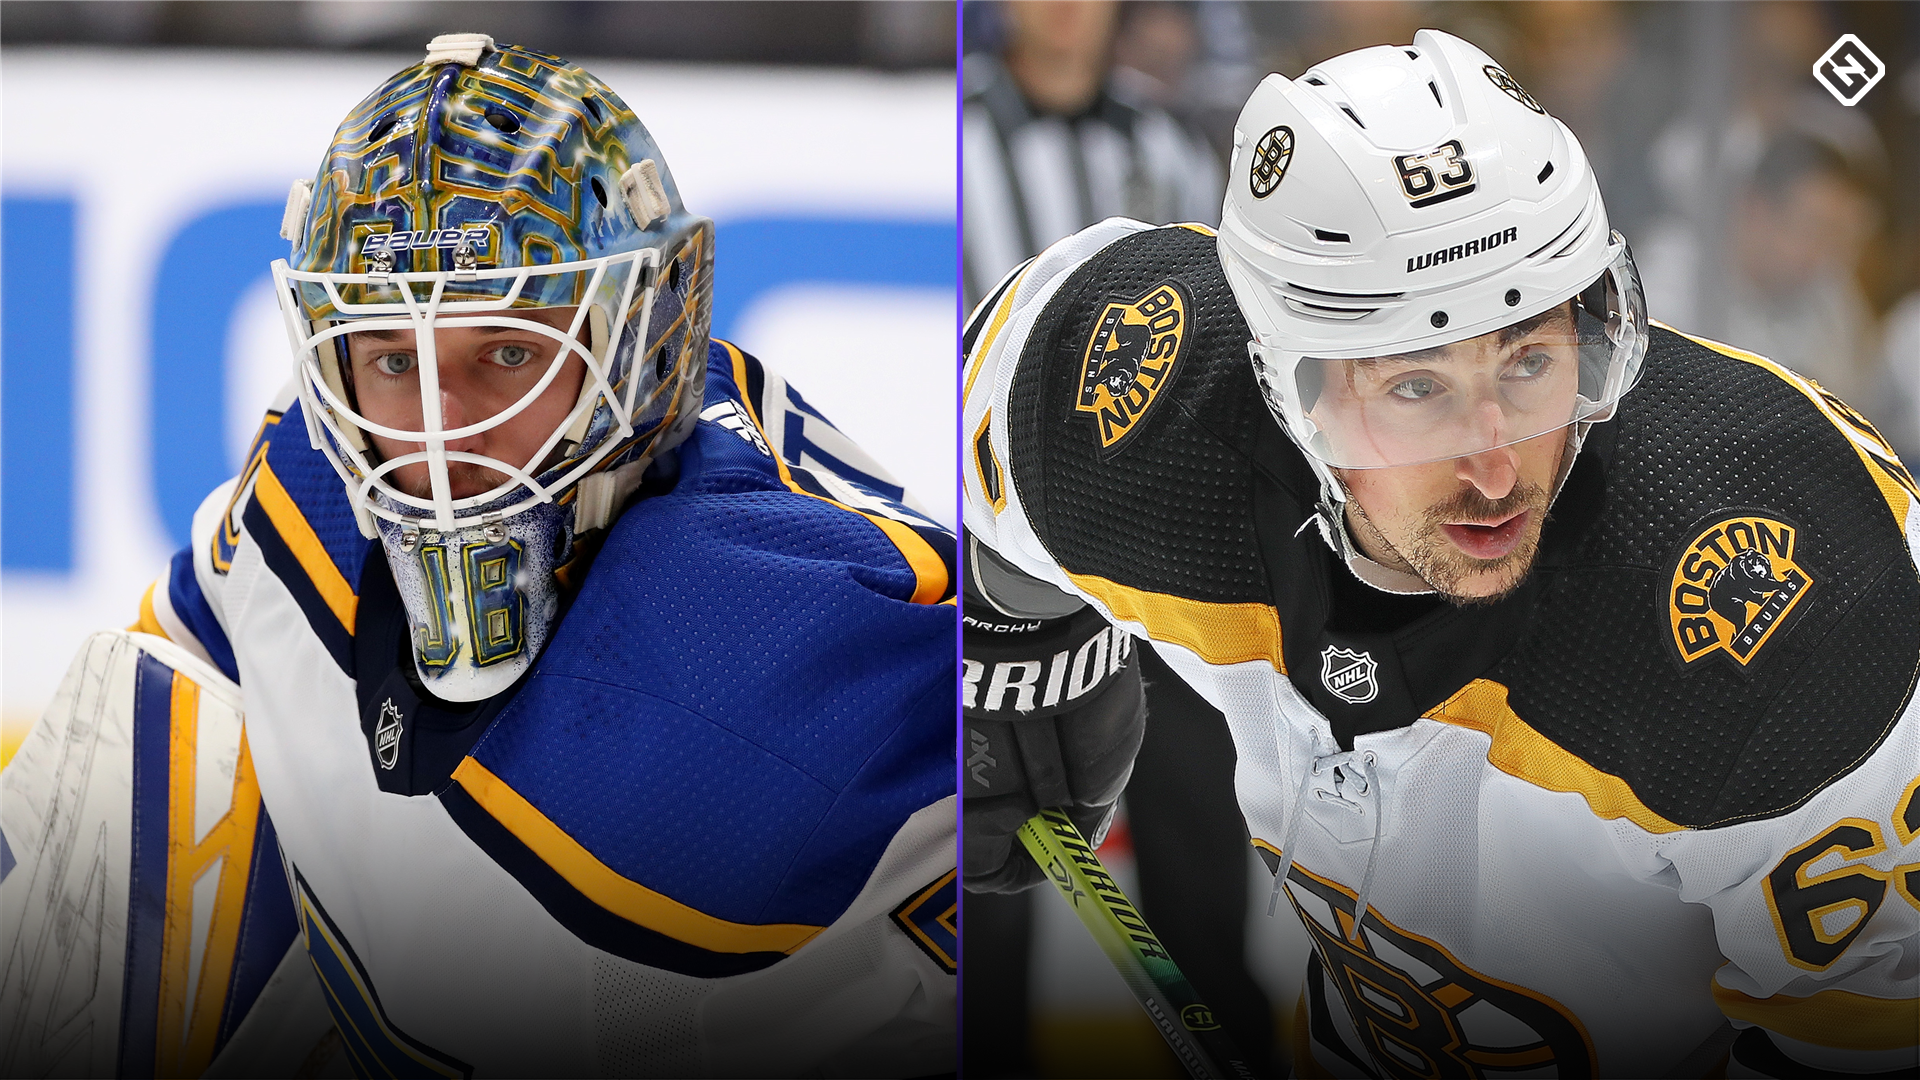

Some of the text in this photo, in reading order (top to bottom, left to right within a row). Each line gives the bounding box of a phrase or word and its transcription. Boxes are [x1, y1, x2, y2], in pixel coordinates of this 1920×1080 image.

[1392, 139, 1476, 201] 63
[1406, 226, 1519, 274] WARRIOR
[1084, 317, 1115, 394] BRUINS
[1100, 289, 1181, 442] BOSTON
[419, 537, 528, 669] JB
[1674, 521, 1790, 656] BOSTON
[1743, 581, 1798, 646] BRUINS
[1333, 665, 1366, 689] NHL
[379, 727, 396, 748] NHL
[1038, 805, 1172, 961] ARRIOR
[1144, 997, 1215, 1080] WARRIO
